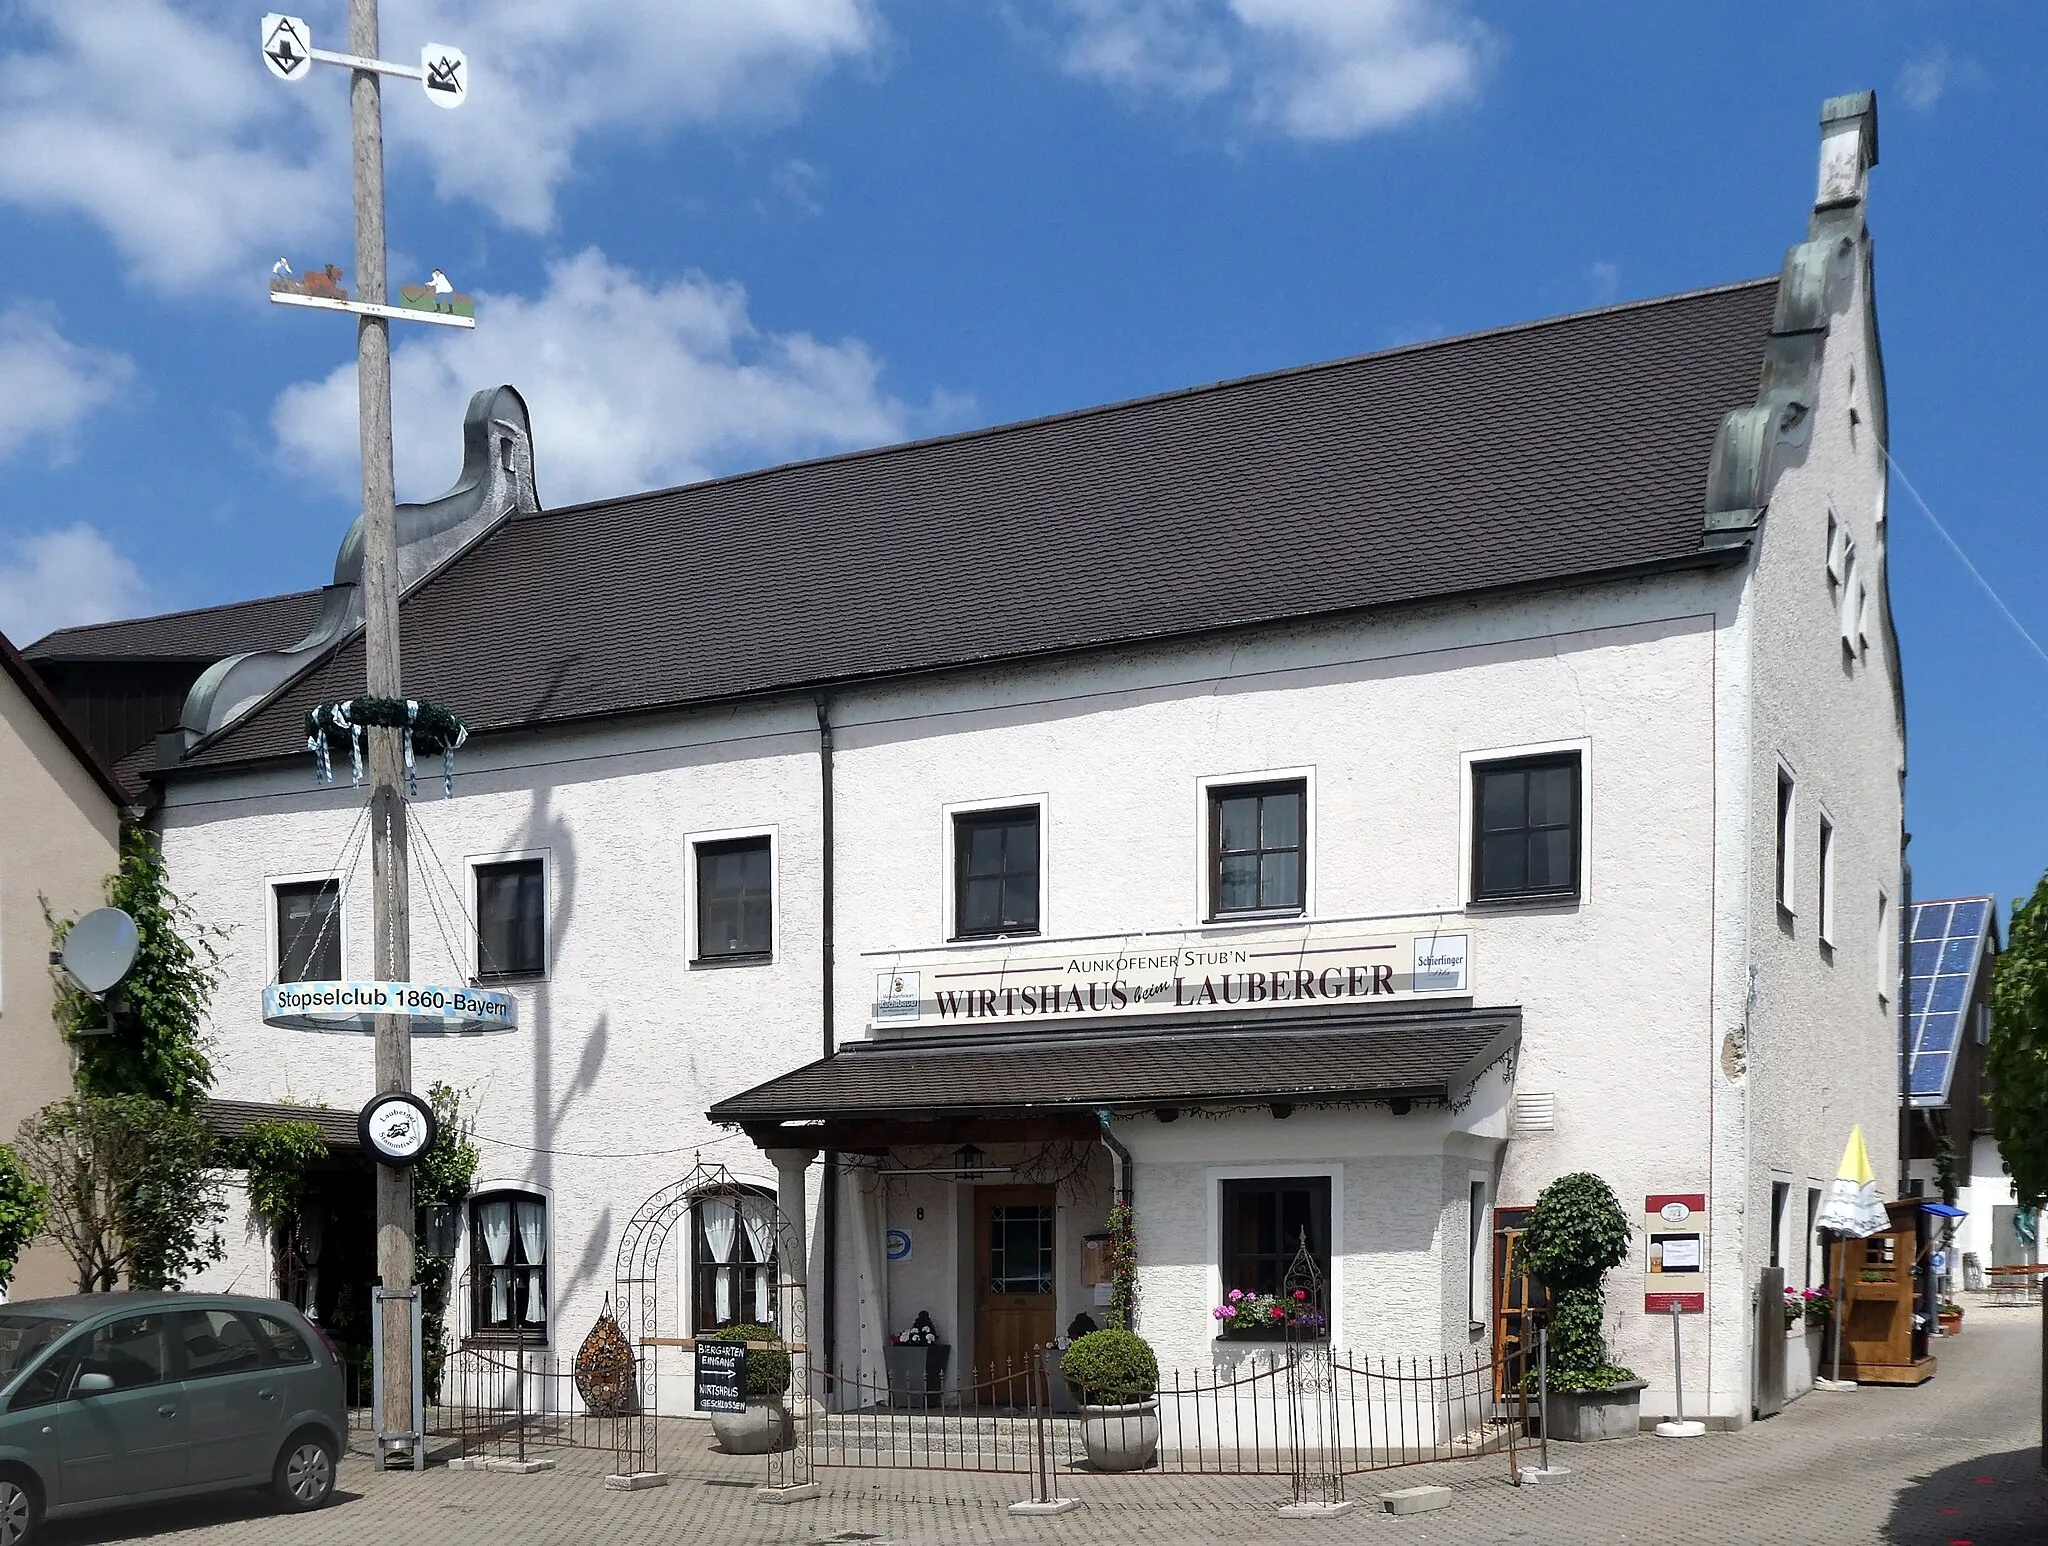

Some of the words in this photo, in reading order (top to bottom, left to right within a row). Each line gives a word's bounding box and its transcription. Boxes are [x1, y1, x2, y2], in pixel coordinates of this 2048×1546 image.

[1067, 955, 1179, 973] AUNKOFENER
[1184, 951, 1246, 967] STUB'N
[1417, 954, 1464, 967] Schierlinger
[934, 979, 1128, 1020] WIRTSHAUS
[1133, 980, 1171, 1003] beim
[1173, 964, 1396, 1007] LAUBERGER
[278, 988, 387, 1012] Stopselclub
[395, 989, 507, 1017] 1860-Bayern
[379, 1108, 417, 1124] Lauberger
[378, 1131, 417, 1149] Stammtisch
[917, 1207, 924, 1220] 8
[698, 1343, 744, 1357] BIERGARTEN
[702, 1355, 736, 1368] EINGANG
[699, 1384, 738, 1397] WIRTSHAUS
[700, 1399, 745, 1411] GESCHLOSSEN
